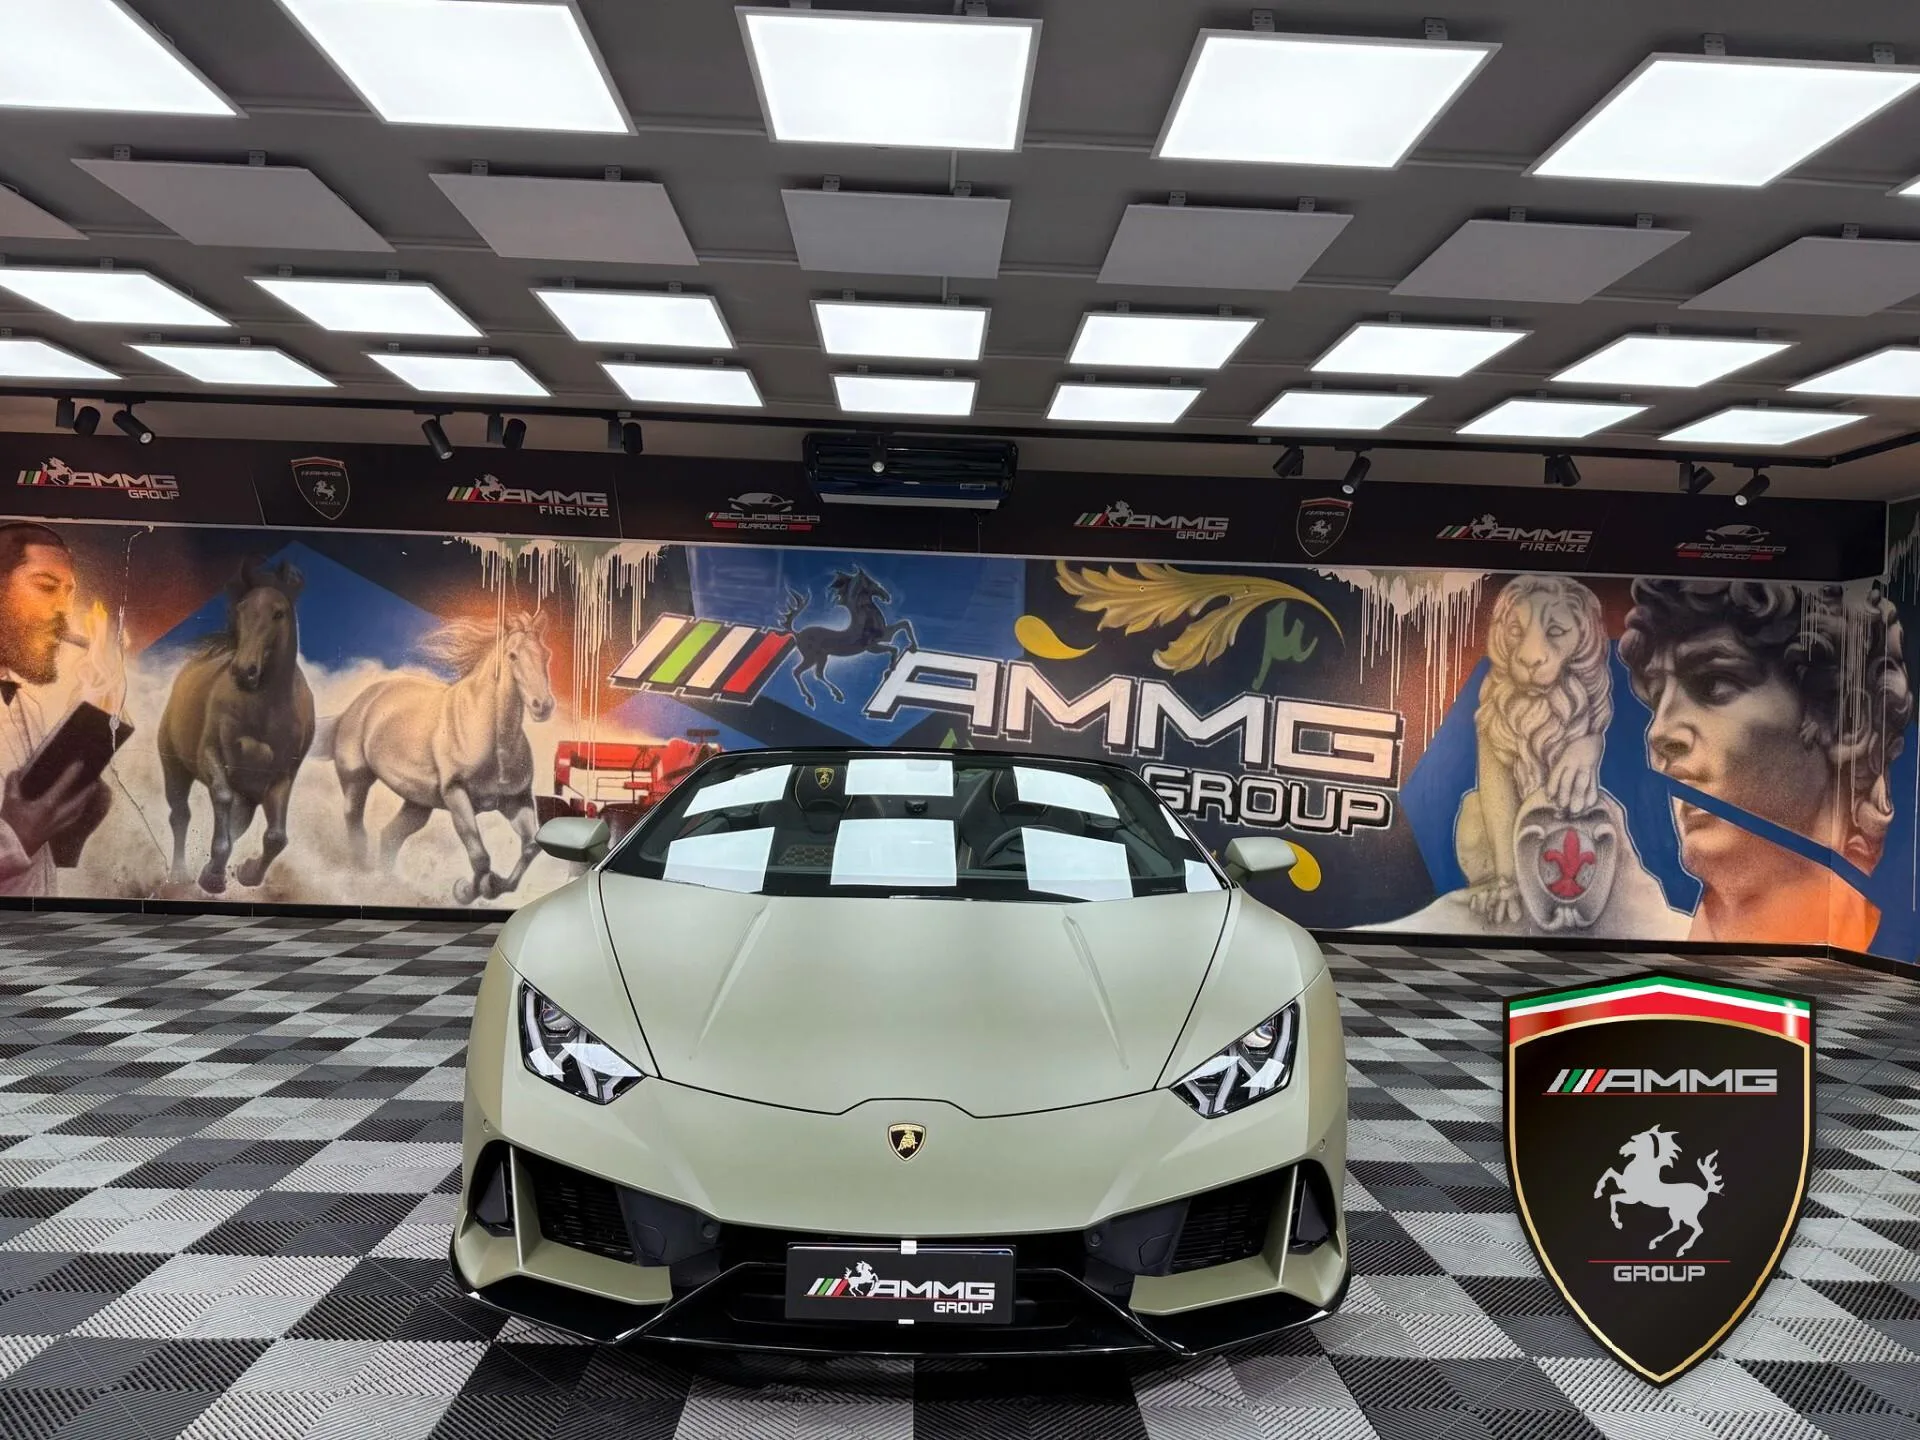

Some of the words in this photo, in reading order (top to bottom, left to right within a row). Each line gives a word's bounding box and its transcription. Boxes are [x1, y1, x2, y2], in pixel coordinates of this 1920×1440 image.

[67, 472, 178, 489] AMMG
[128, 489, 180, 501] GROUP
[499, 489, 608, 506] AMMG
[539, 505, 609, 518] FIRENZE
[717, 512, 820, 523] SCUDERIA
[1126, 515, 1229, 530] AMMG
[1176, 530, 1226, 541] GROUP
[1488, 528, 1593, 543] AMMG
[1519, 542, 1587, 553] FIRENZE
[865, 649, 1402, 785] AMMG
[1142, 764, 1390, 834] GROUP
[868, 1279, 995, 1300] AMMG
[933, 1301, 994, 1314] GROUP
